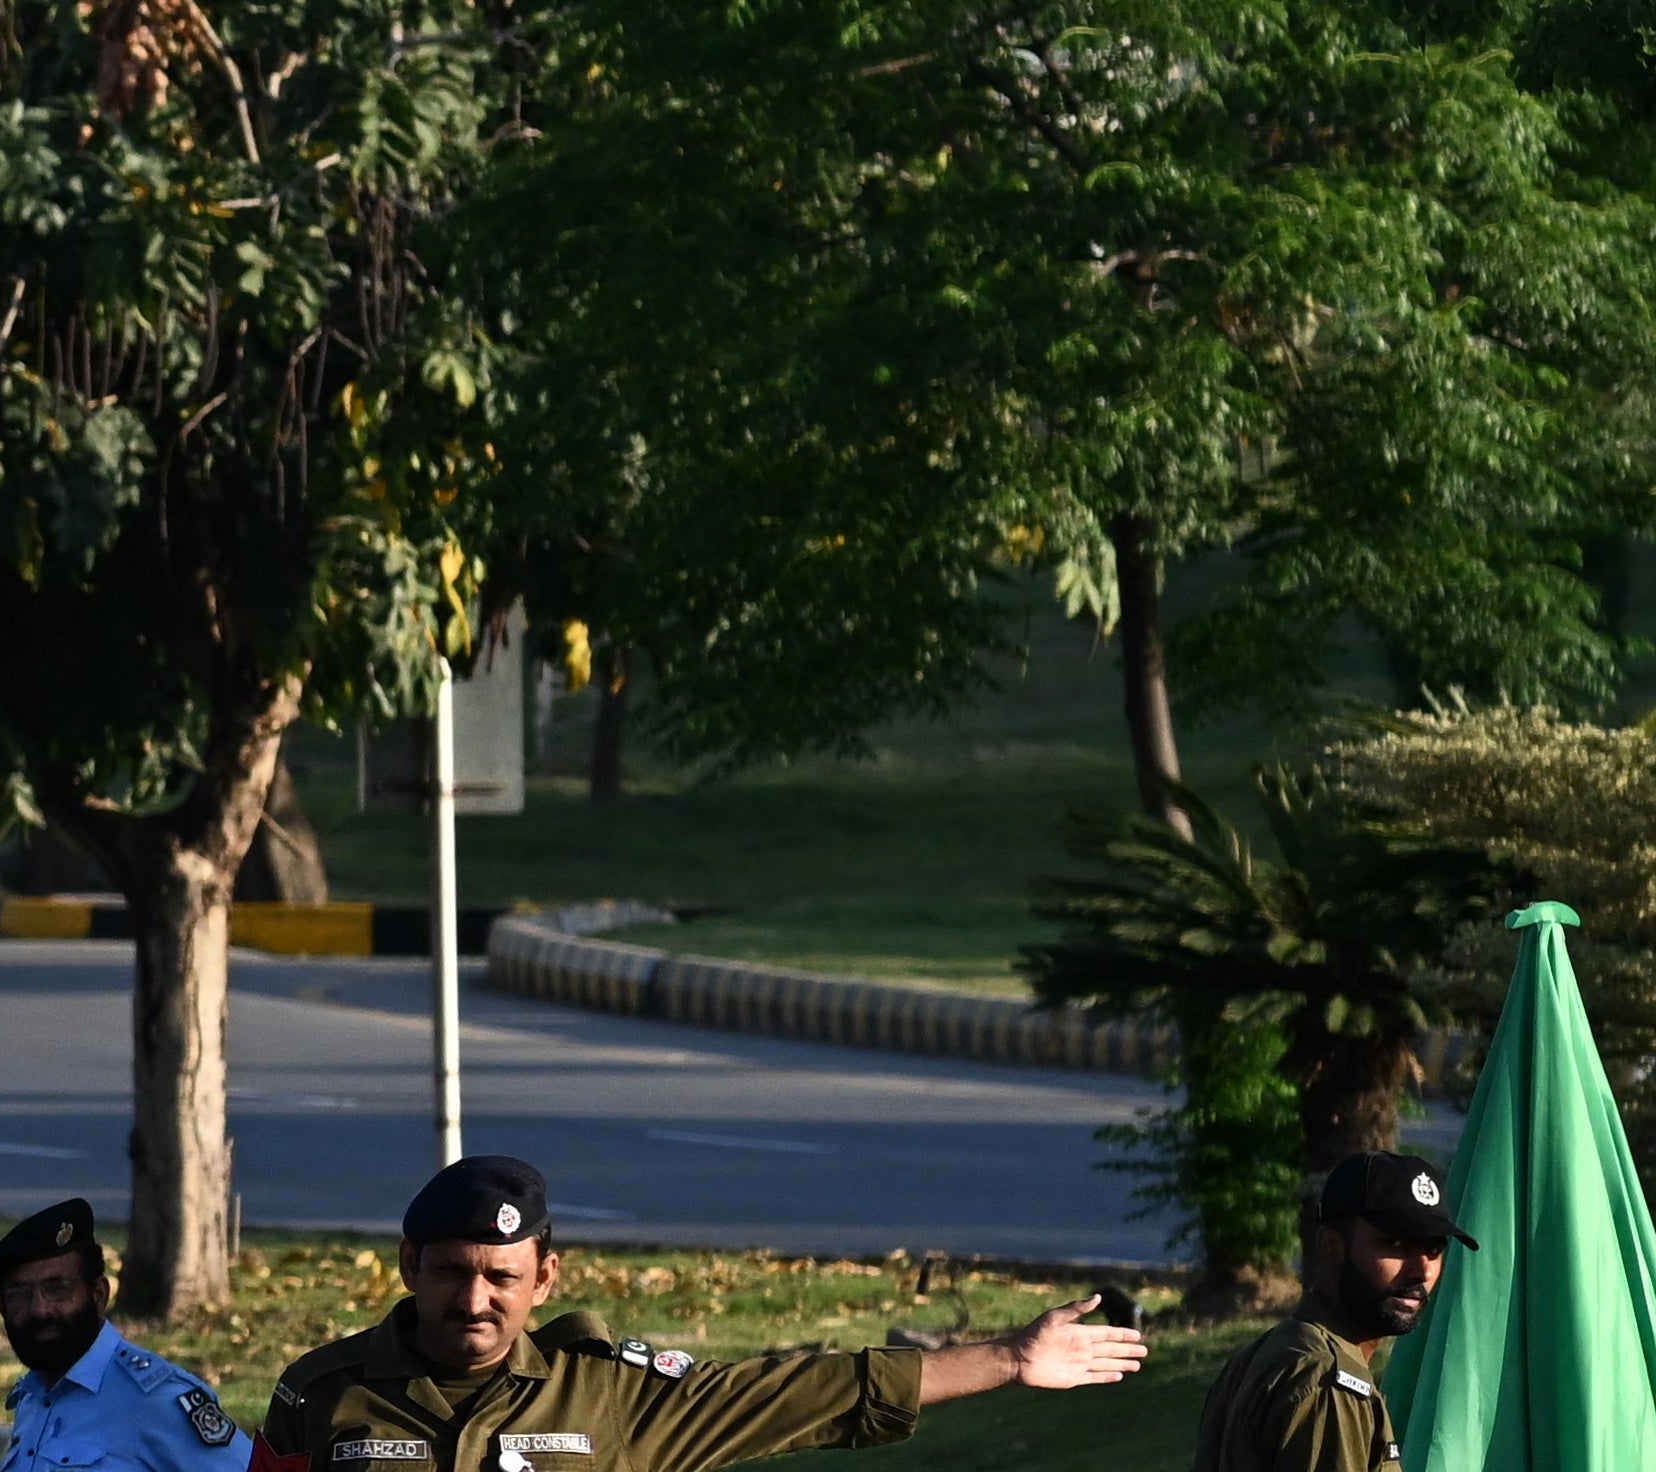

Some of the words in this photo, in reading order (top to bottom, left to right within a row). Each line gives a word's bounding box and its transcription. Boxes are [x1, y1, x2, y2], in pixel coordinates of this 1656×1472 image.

[342, 1442, 418, 1457] SHAHZAD
[503, 1437, 531, 1450] HEAD
[533, 1436, 589, 1450] CONSTABLE
